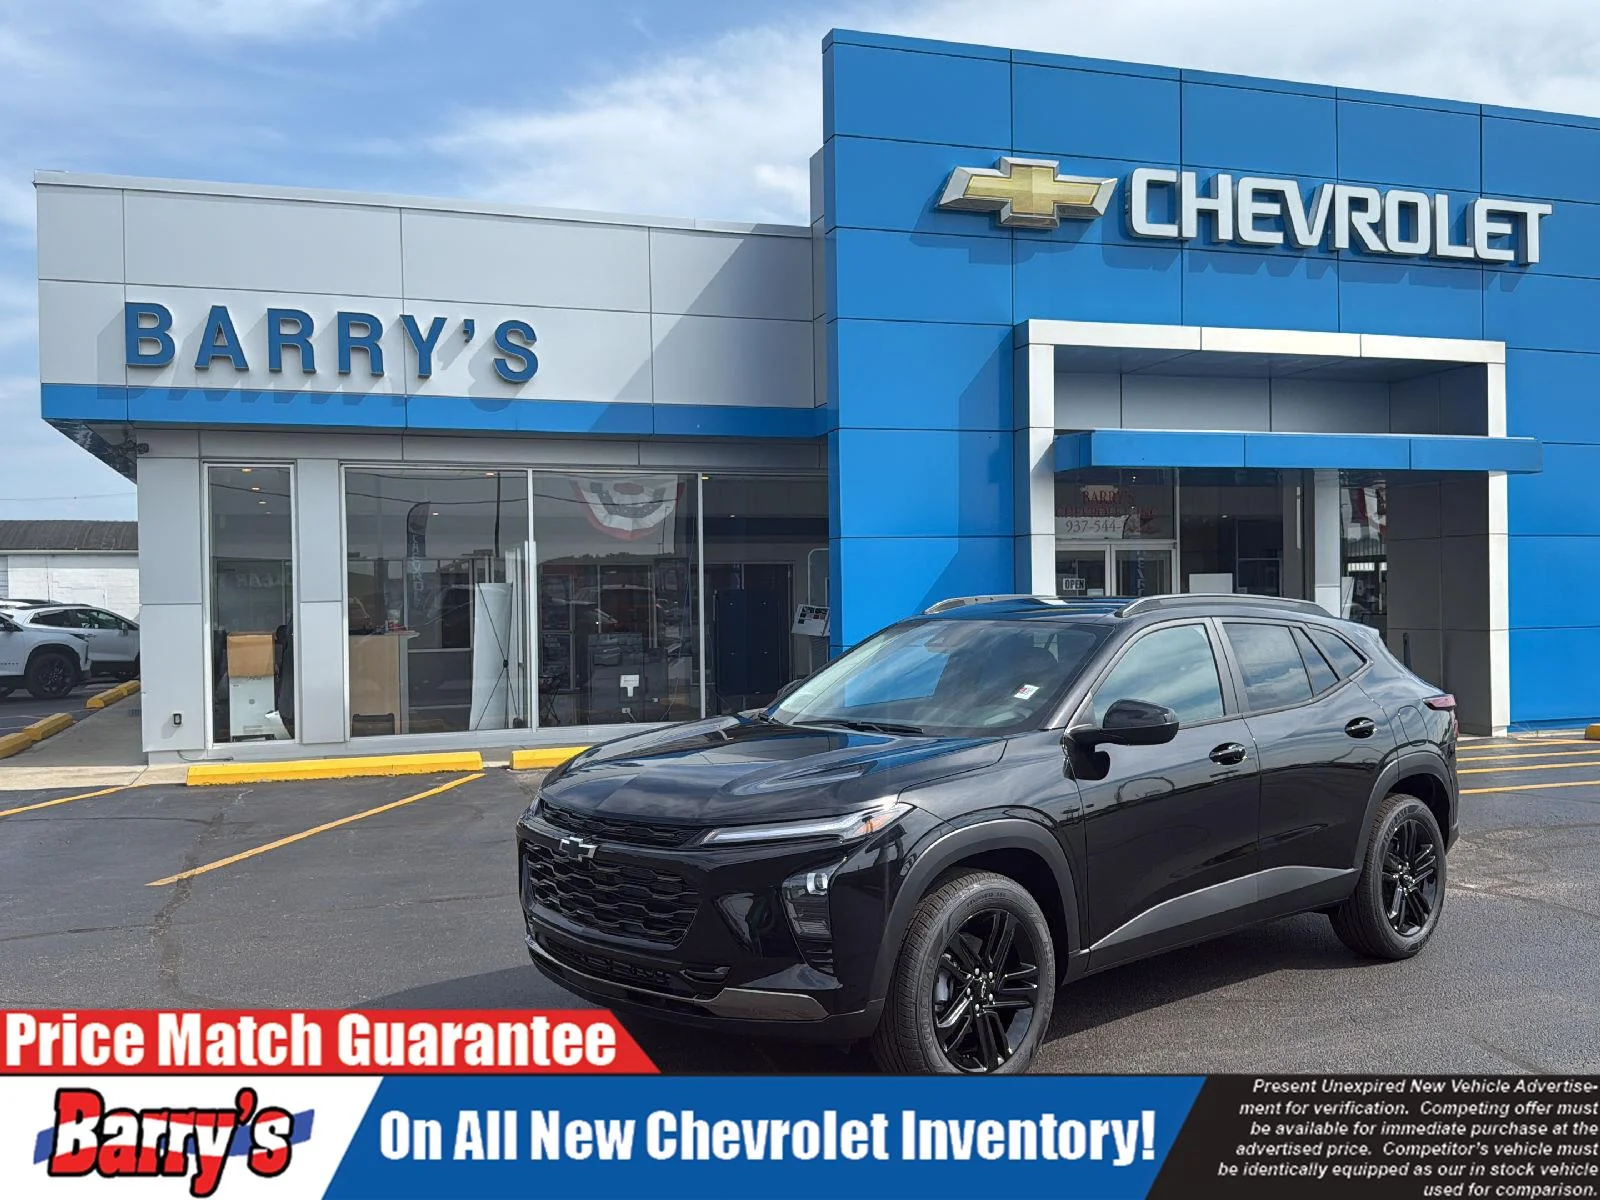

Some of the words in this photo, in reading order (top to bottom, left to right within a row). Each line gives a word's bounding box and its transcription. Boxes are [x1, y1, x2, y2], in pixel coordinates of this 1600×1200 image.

[1128, 167, 1553, 264] CHEVROLET
[124, 301, 539, 384] BARRY'S
[1065, 579, 1084, 589] OPEN
